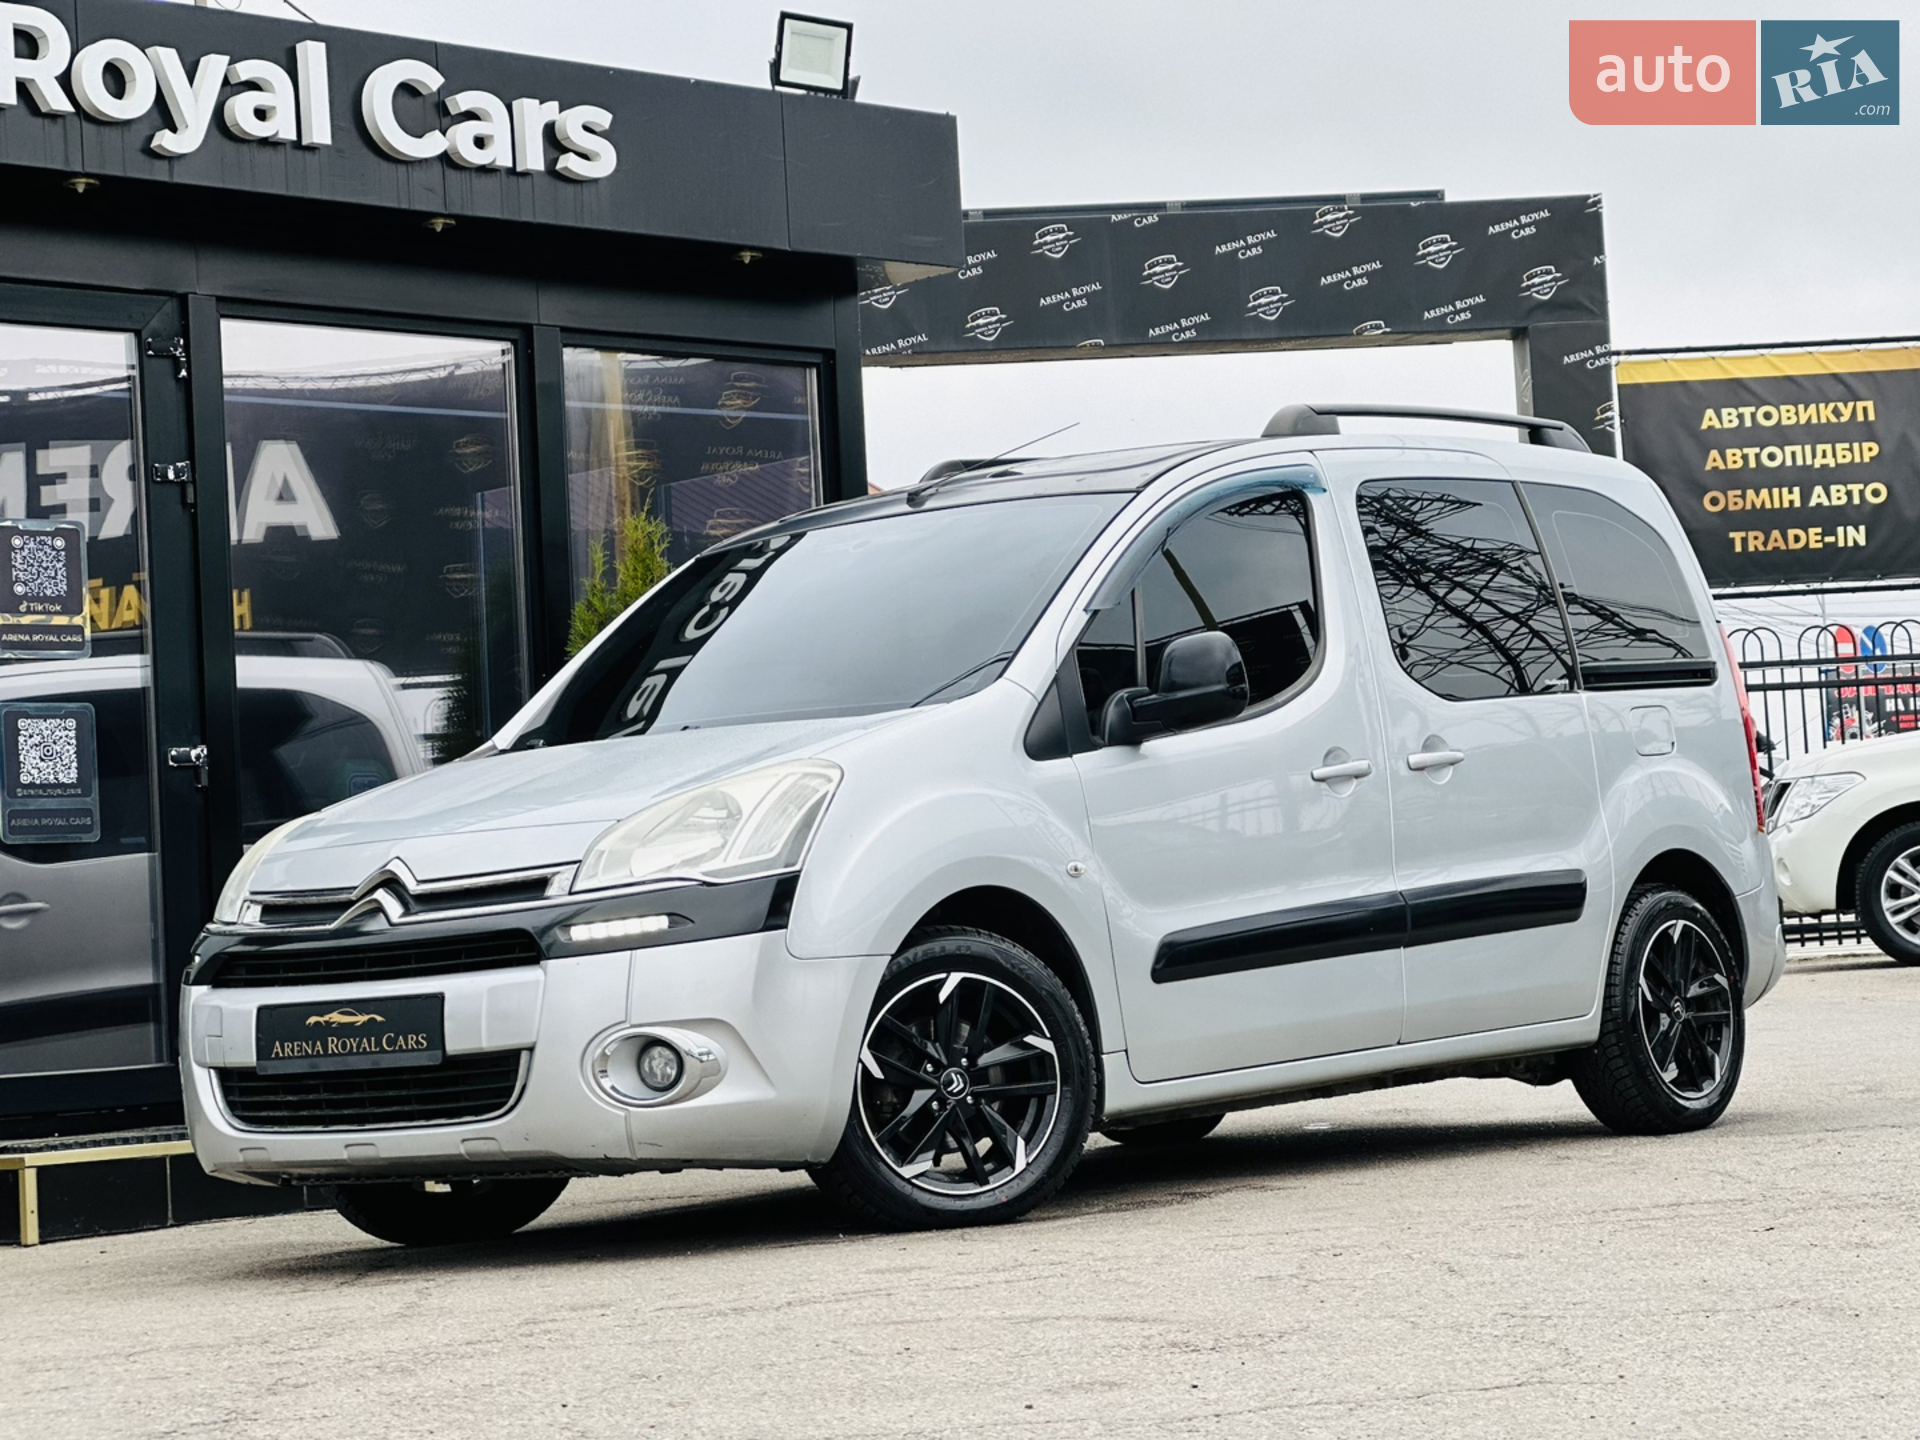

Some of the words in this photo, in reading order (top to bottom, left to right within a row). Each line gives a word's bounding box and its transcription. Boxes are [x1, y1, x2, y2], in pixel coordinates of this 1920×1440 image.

[0, 2, 332, 156] Royal
[361, 59, 617, 180] Cars
[1488, 219, 1520, 235] ARENA
[1519, 209, 1551, 225] ROYAL
[1511, 225, 1536, 239] CARS
[1215, 239, 1246, 255] ARENA
[1246, 229, 1277, 245] ROYAL
[966, 249, 998, 265] ROYAL
[1238, 245, 1263, 259] CARS
[958, 265, 983, 280] CARS
[1320, 270, 1352, 286] ARENA
[1352, 260, 1383, 276] ROYAL
[1343, 276, 1368, 290] CARS
[1040, 291, 1071, 307] ARENA
[1071, 282, 1102, 297] ROYAL
[1063, 297, 1088, 311] CARS
[1423, 304, 1455, 320] ARENA
[1455, 294, 1486, 310] ROYAL
[1149, 322, 1180, 338] ARENA
[1180, 312, 1211, 328] ROYAL
[1446, 310, 1472, 324] CARS
[897, 333, 929, 348] ROYAL
[1171, 328, 1197, 342] CARS
[1563, 349, 1595, 365] ARENA
[1700, 400, 1876, 430] АВТОВИКУП
[1704, 441, 1880, 471] АВТОПІДБІР
[1703, 486, 1801, 513] ОБМІН
[1808, 482, 1888, 507] АВТО
[1729, 525, 1867, 553] TRADE-IN
[29, 602, 62, 612] TikTok
[1, 633, 30, 641] ARENA
[32, 634, 59, 642] ROYAL
[60, 634, 82, 642] CARS
[10, 818, 39, 827] ARENA
[41, 817, 68, 826] ROYAL
[271, 1040, 324, 1058] ARENA
[327, 1036, 380, 1054] ROYAL
[382, 1033, 428, 1050] CARS
